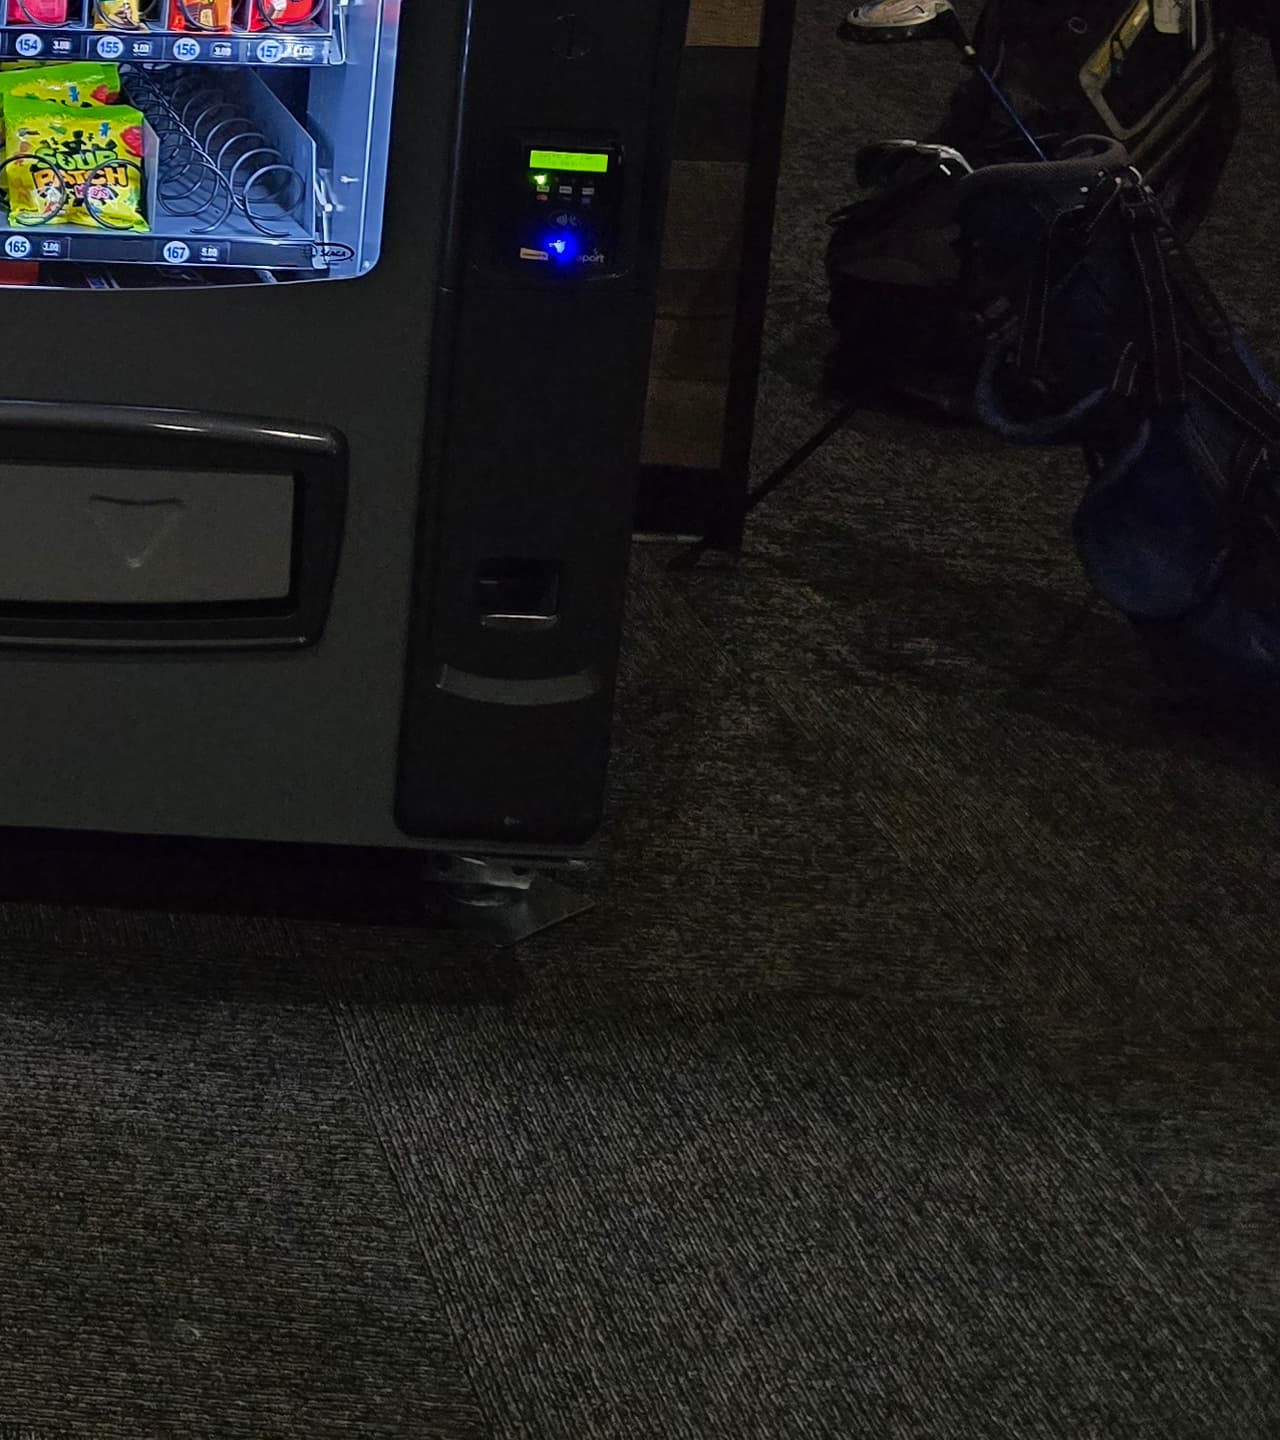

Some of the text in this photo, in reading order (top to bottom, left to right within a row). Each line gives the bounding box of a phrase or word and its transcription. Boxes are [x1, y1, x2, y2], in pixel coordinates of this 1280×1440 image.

[17, 38, 39, 53] 154
[99, 41, 120, 55] 155
[175, 42, 197, 57] 156
[259, 45, 280, 59] 157
[35, 148, 119, 168] SOUR
[33, 166, 129, 188] PATCH
[7, 240, 29, 254] 165
[165, 245, 187, 260] 167
